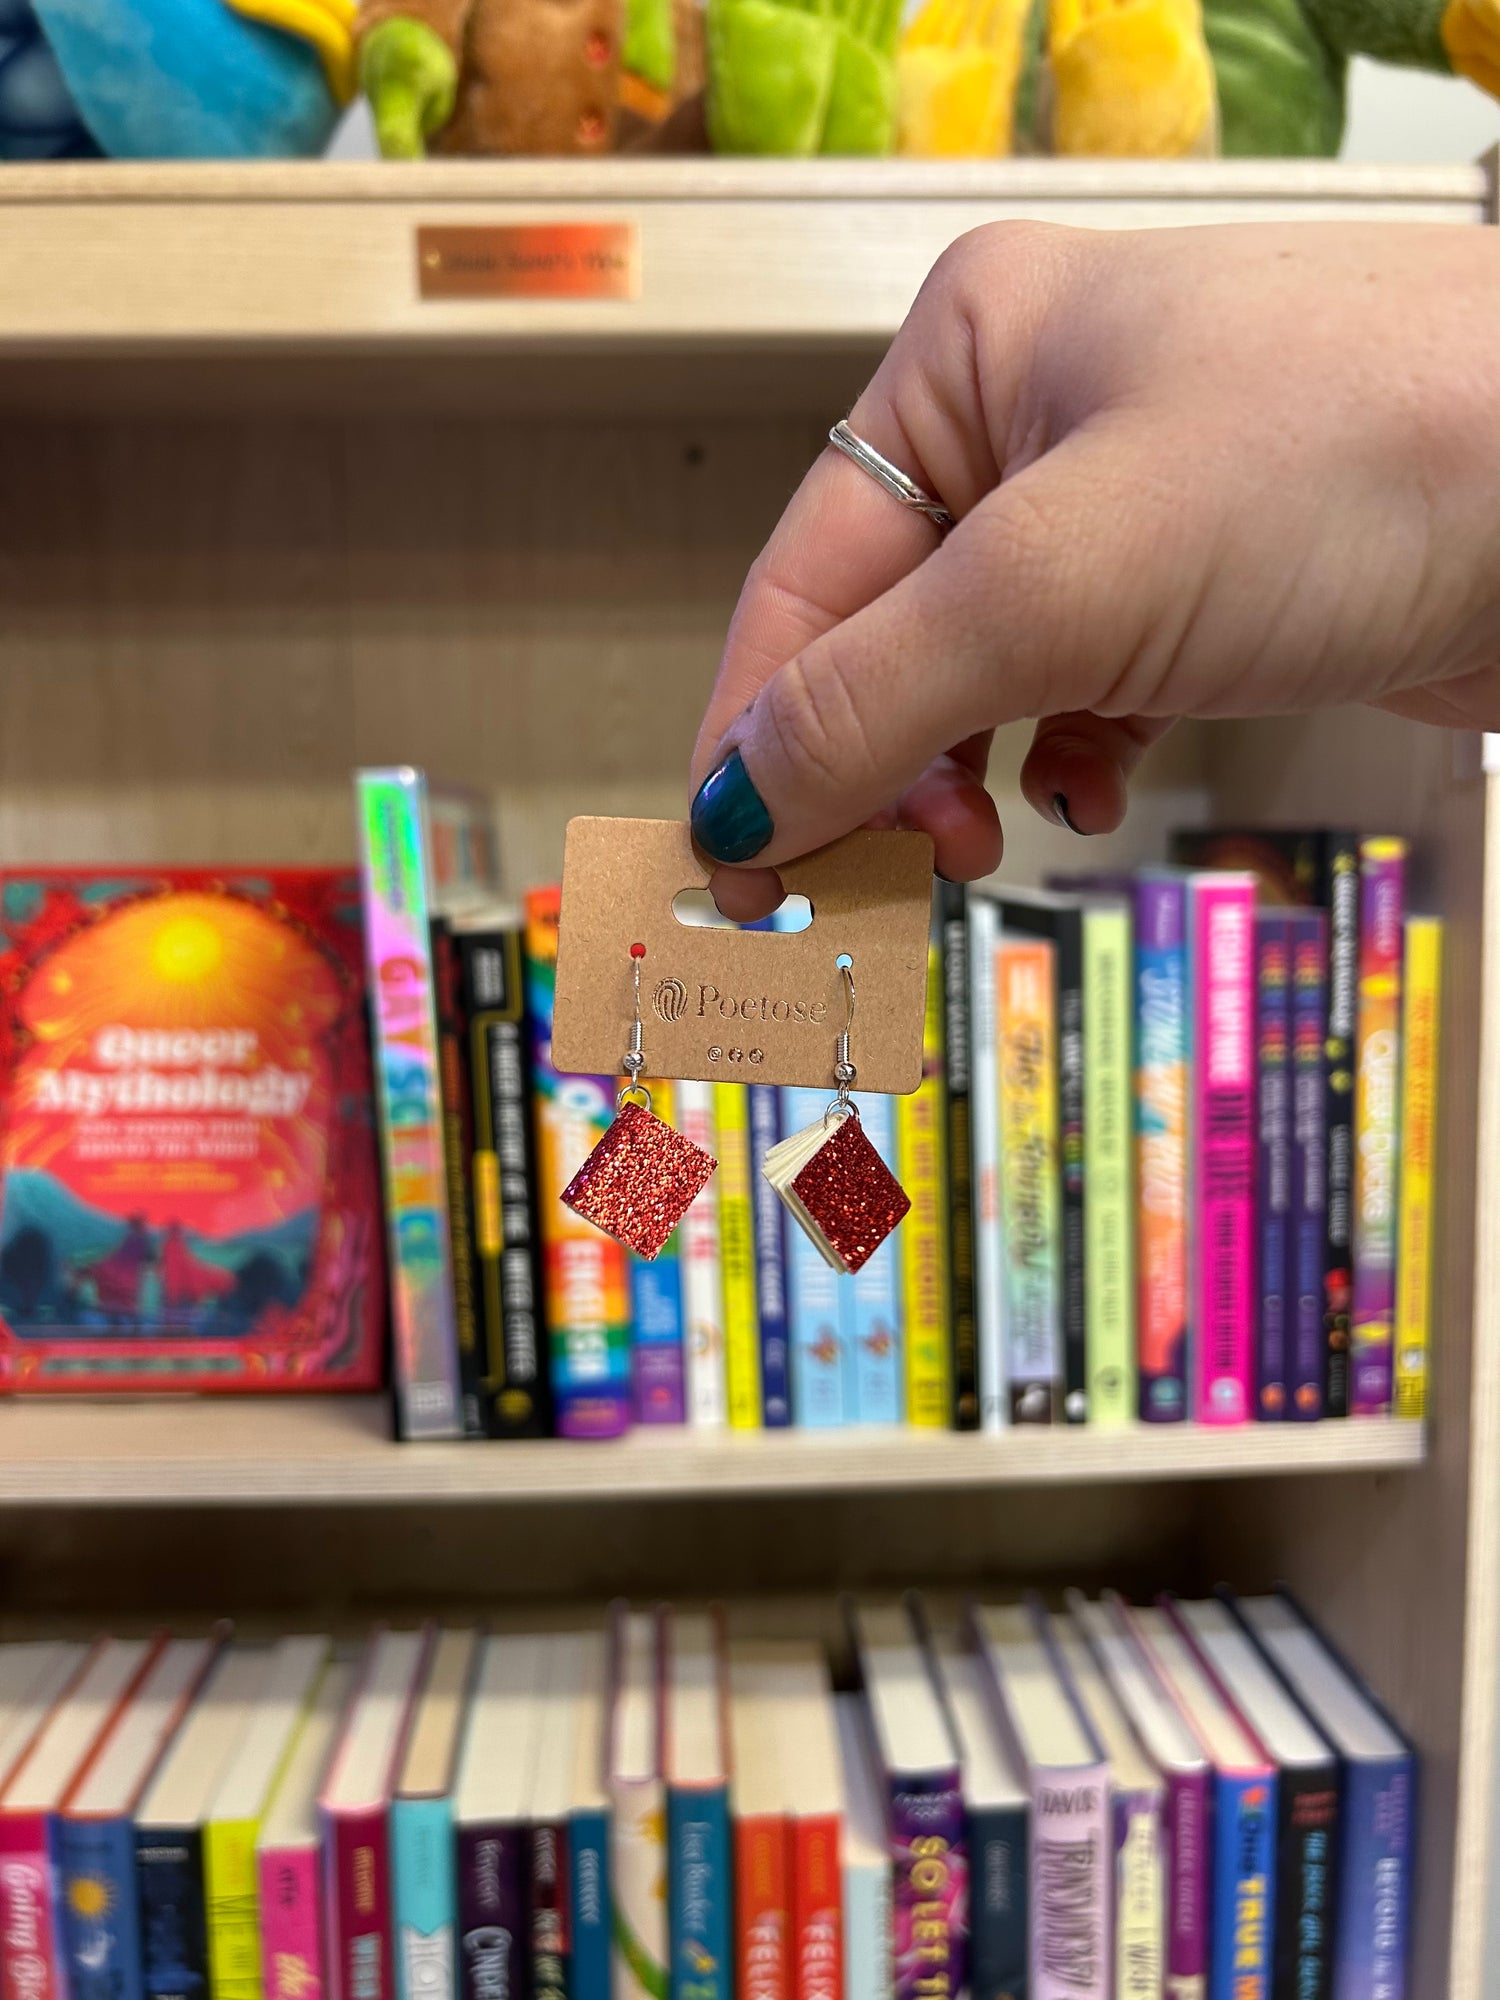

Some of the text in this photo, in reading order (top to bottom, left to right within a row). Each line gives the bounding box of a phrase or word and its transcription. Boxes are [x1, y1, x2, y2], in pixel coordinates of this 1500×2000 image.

[696, 984, 827, 1024] Poetose
[98, 1024, 259, 1068] Queer
[36, 1066, 311, 1116] Mythology
[381, 956, 443, 1268] GAY SCIENCE
[564, 1241, 606, 1379] ENGLISH
[909, 1836, 949, 1890] SO
[3, 1864, 42, 1950] Going
[910, 1901, 950, 1962] LET
[1234, 1874, 1266, 1968] TRUE
[1373, 1857, 1400, 1950] BEYOND
[747, 1925, 780, 2000] FELIX
[803, 1924, 835, 2000] FELIX
